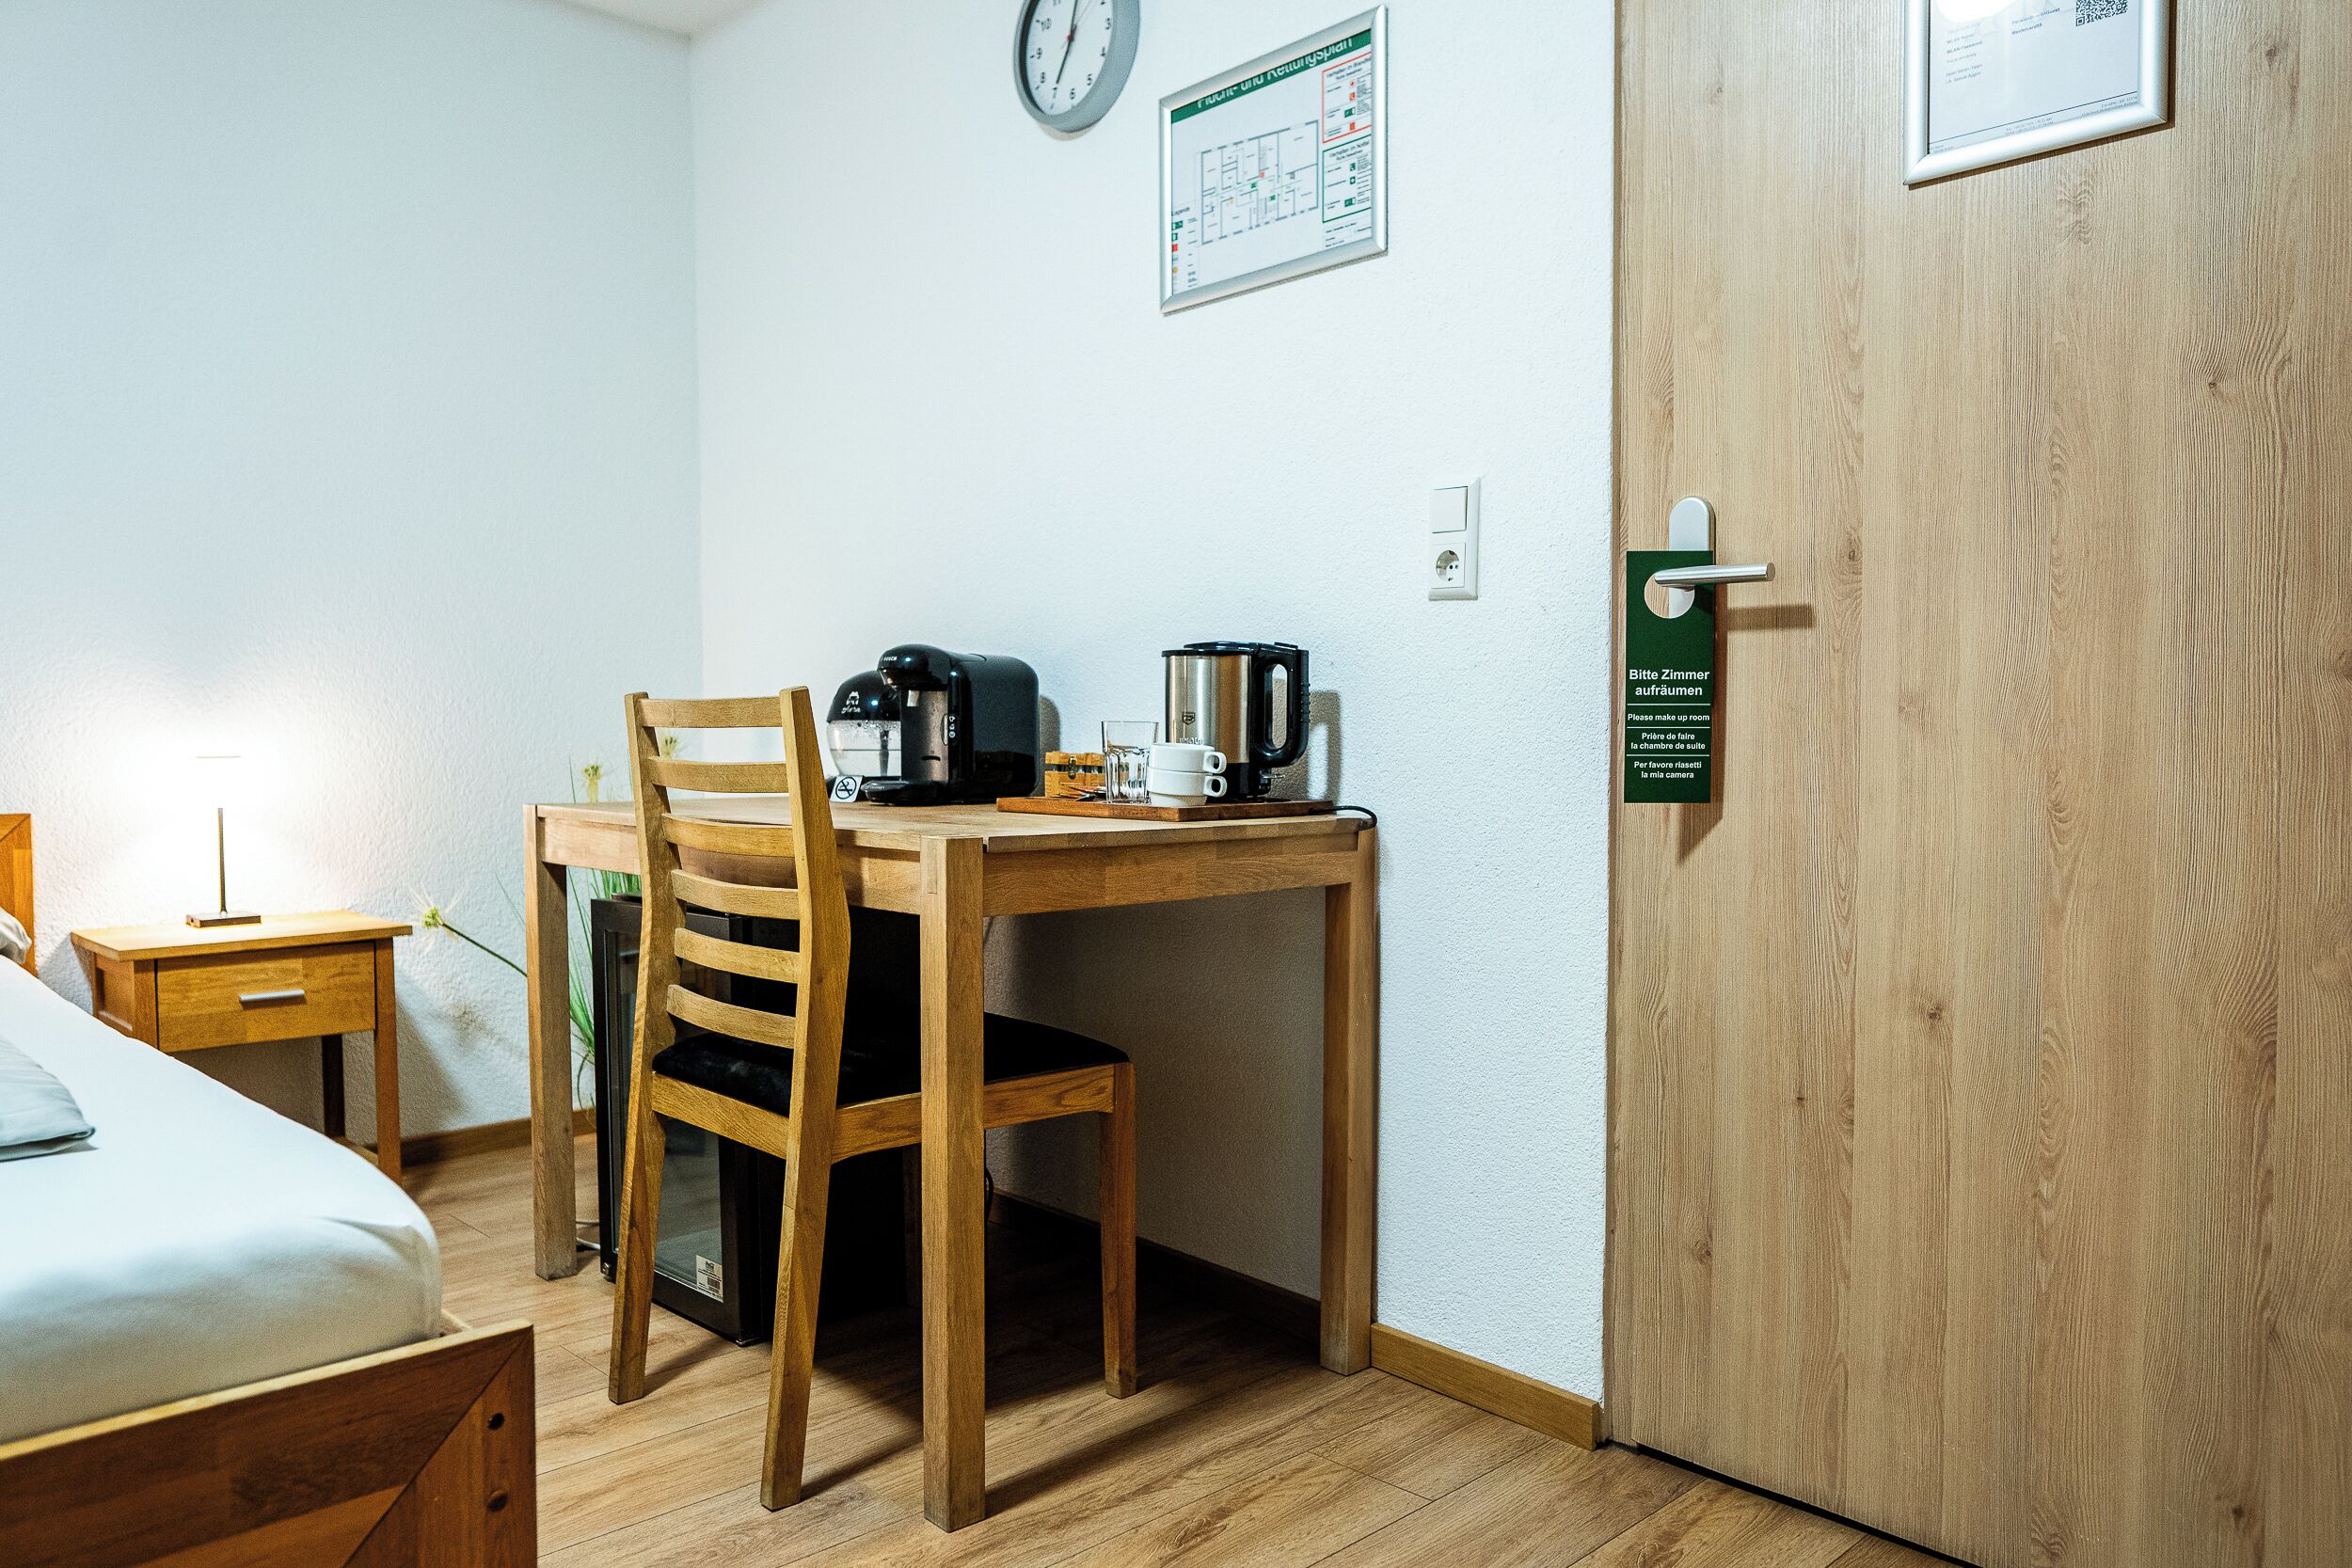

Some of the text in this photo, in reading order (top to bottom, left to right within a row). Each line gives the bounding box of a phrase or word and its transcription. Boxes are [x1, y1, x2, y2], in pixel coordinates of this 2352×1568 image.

[1104, 17, 1111, 30] 3
[1037, 47, 1042, 59] 9
[1241, 75, 1264, 91] und
[1267, 38, 1353, 80] Rettungsplan
[1040, 71, 1046, 84] 8
[1087, 73, 1092, 86] 5
[1070, 87, 1075, 100] 6
[1629, 669, 1710, 680] Bitte Zimmer
[1635, 685, 1703, 696] aufräumen
[1628, 713, 1654, 721] Please
[1655, 713, 1676, 721] make
[1641, 732, 1665, 740] Prière
[1677, 732, 1695, 740] faire
